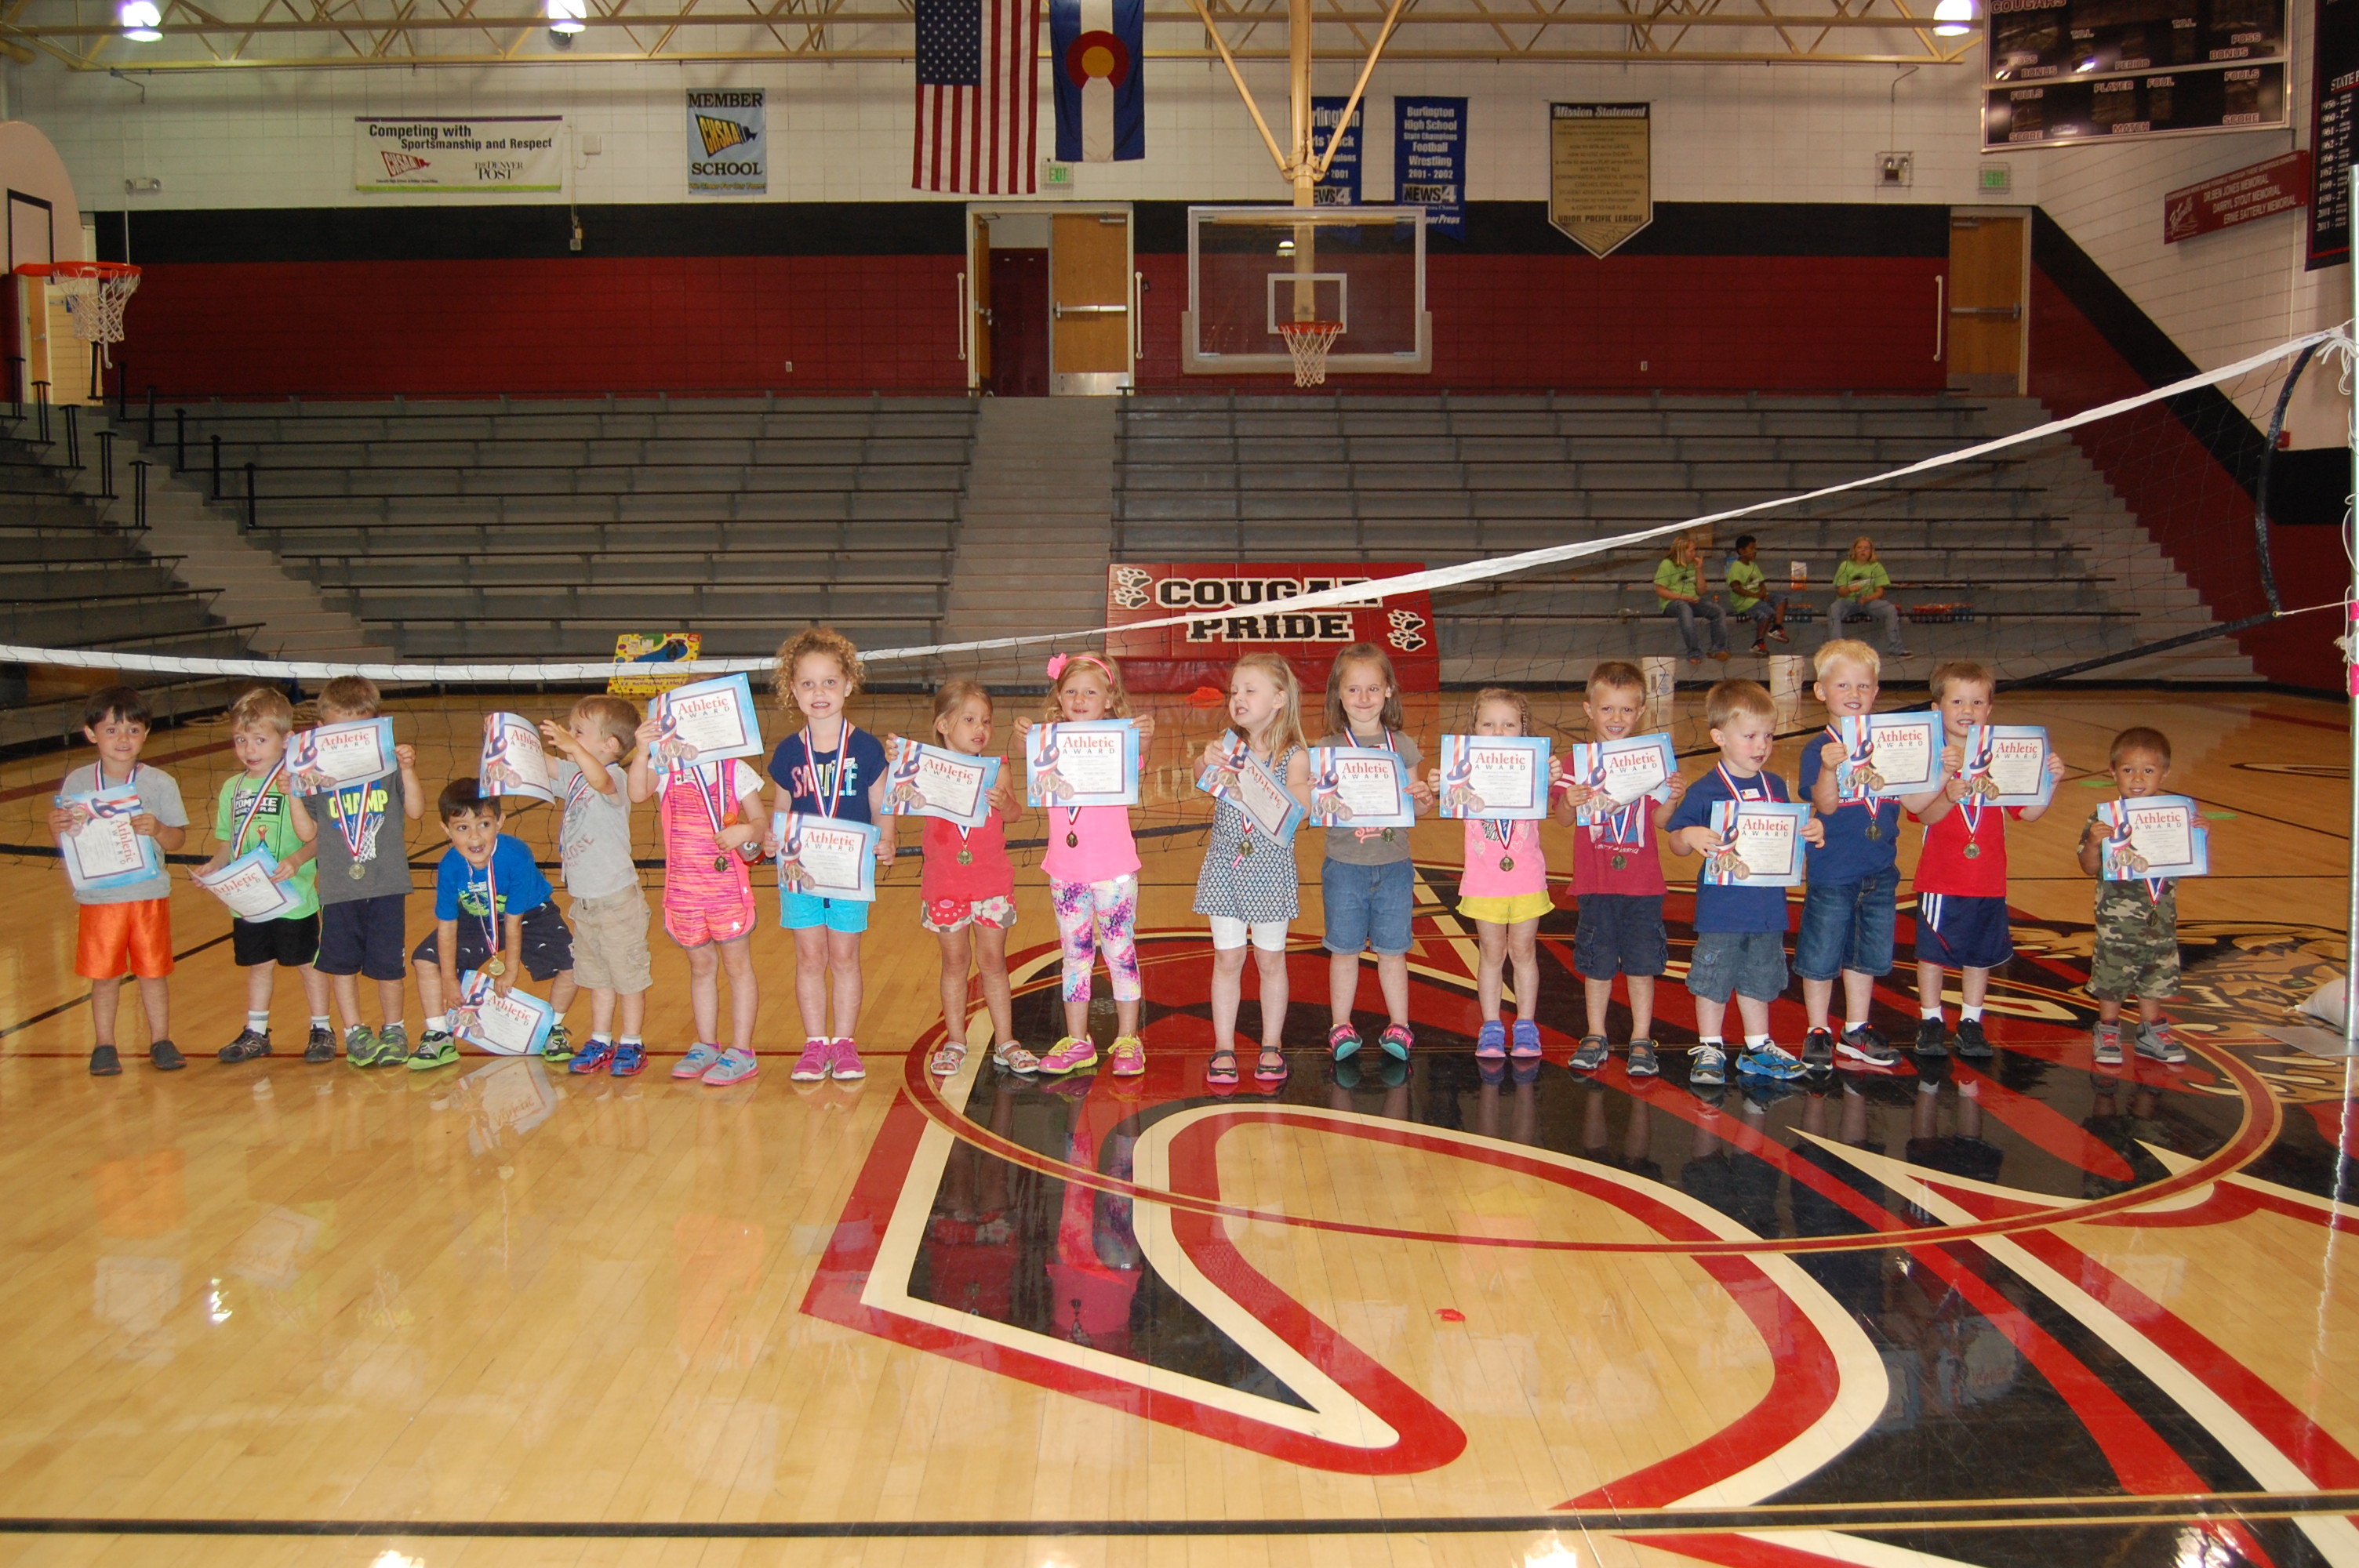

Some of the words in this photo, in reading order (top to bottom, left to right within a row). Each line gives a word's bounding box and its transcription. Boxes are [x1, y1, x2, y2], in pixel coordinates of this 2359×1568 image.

[2230, 32, 2261, 45] POSS
[2209, 47, 2248, 60] BONUS
[2114, 59, 2150, 71] PERIOD
[2021, 66, 2058, 78] BONUS
[2223, 69, 2260, 82] FOULS
[2094, 81, 2134, 93] PLAYER
[2146, 77, 2175, 89] FOUL
[2331, 72, 2354, 92] STATE
[689, 93, 762, 107] MEMBER
[2010, 89, 2043, 100] FOULS
[1407, 107, 1455, 118] Burlington
[1554, 106, 1593, 118] Mission
[1595, 105, 1647, 118] Statement
[1405, 120, 1425, 131] High
[1426, 120, 1457, 130] School
[2223, 113, 2259, 125] SCORE
[369, 125, 438, 140] Competing
[443, 125, 471, 136] with
[2112, 122, 2150, 134] MATCH
[699, 116, 742, 154] CHSAA
[1421, 132, 1458, 141] Champions
[2008, 130, 2043, 142] SCORE
[402, 139, 482, 151] Sportsmanship
[485, 138, 506, 149] and
[510, 138, 552, 151] Respect
[1412, 142, 1448, 153] Football
[488, 161, 523, 169] DENVER
[1408, 155, 1452, 167] Wrestling
[478, 168, 514, 180] POST
[692, 162, 763, 176] SCHOOL
[1049, 167, 1067, 182] EXIT
[1408, 169, 1427, 179] 2001
[1434, 169, 1453, 179] 2002
[2223, 181, 2239, 196] JONES
[2241, 172, 2268, 191] MEMORIAL
[1314, 187, 1352, 205] EWS4
[2234, 192, 2251, 207] STOUT
[2252, 183, 2280, 201] MEMORIAL
[2267, 194, 2295, 212] MEMORIAL
[1186, 612, 1354, 642] PRIDE
[678, 696, 728, 716] Athletic
[679, 706, 730, 720] AWARD
[321, 731, 370, 747] Athletic
[1063, 736, 1114, 748] Athletic
[1877, 730, 1922, 742] Athletic
[320, 740, 370, 752] AWARD
[1996, 742, 2037, 753] Athletic
[1475, 753, 1525, 764] Athletic
[1608, 753, 1656, 768] Athletic
[923, 759, 973, 780] Athletic
[1342, 763, 1388, 774] Athletic
[1609, 764, 1657, 774] AWARD
[922, 768, 972, 785] AWARD
[1247, 765, 1282, 807] Athletic
[1742, 818, 1788, 831] Athletic
[2135, 811, 2182, 825] Athletic
[109, 821, 125, 866] AWARD
[117, 819, 134, 863] Athletic
[805, 832, 855, 846] Athletic
[211, 872, 259, 895] Athletic
[485, 1000, 529, 1026] AWARD
[489, 994, 532, 1021] Athletic
